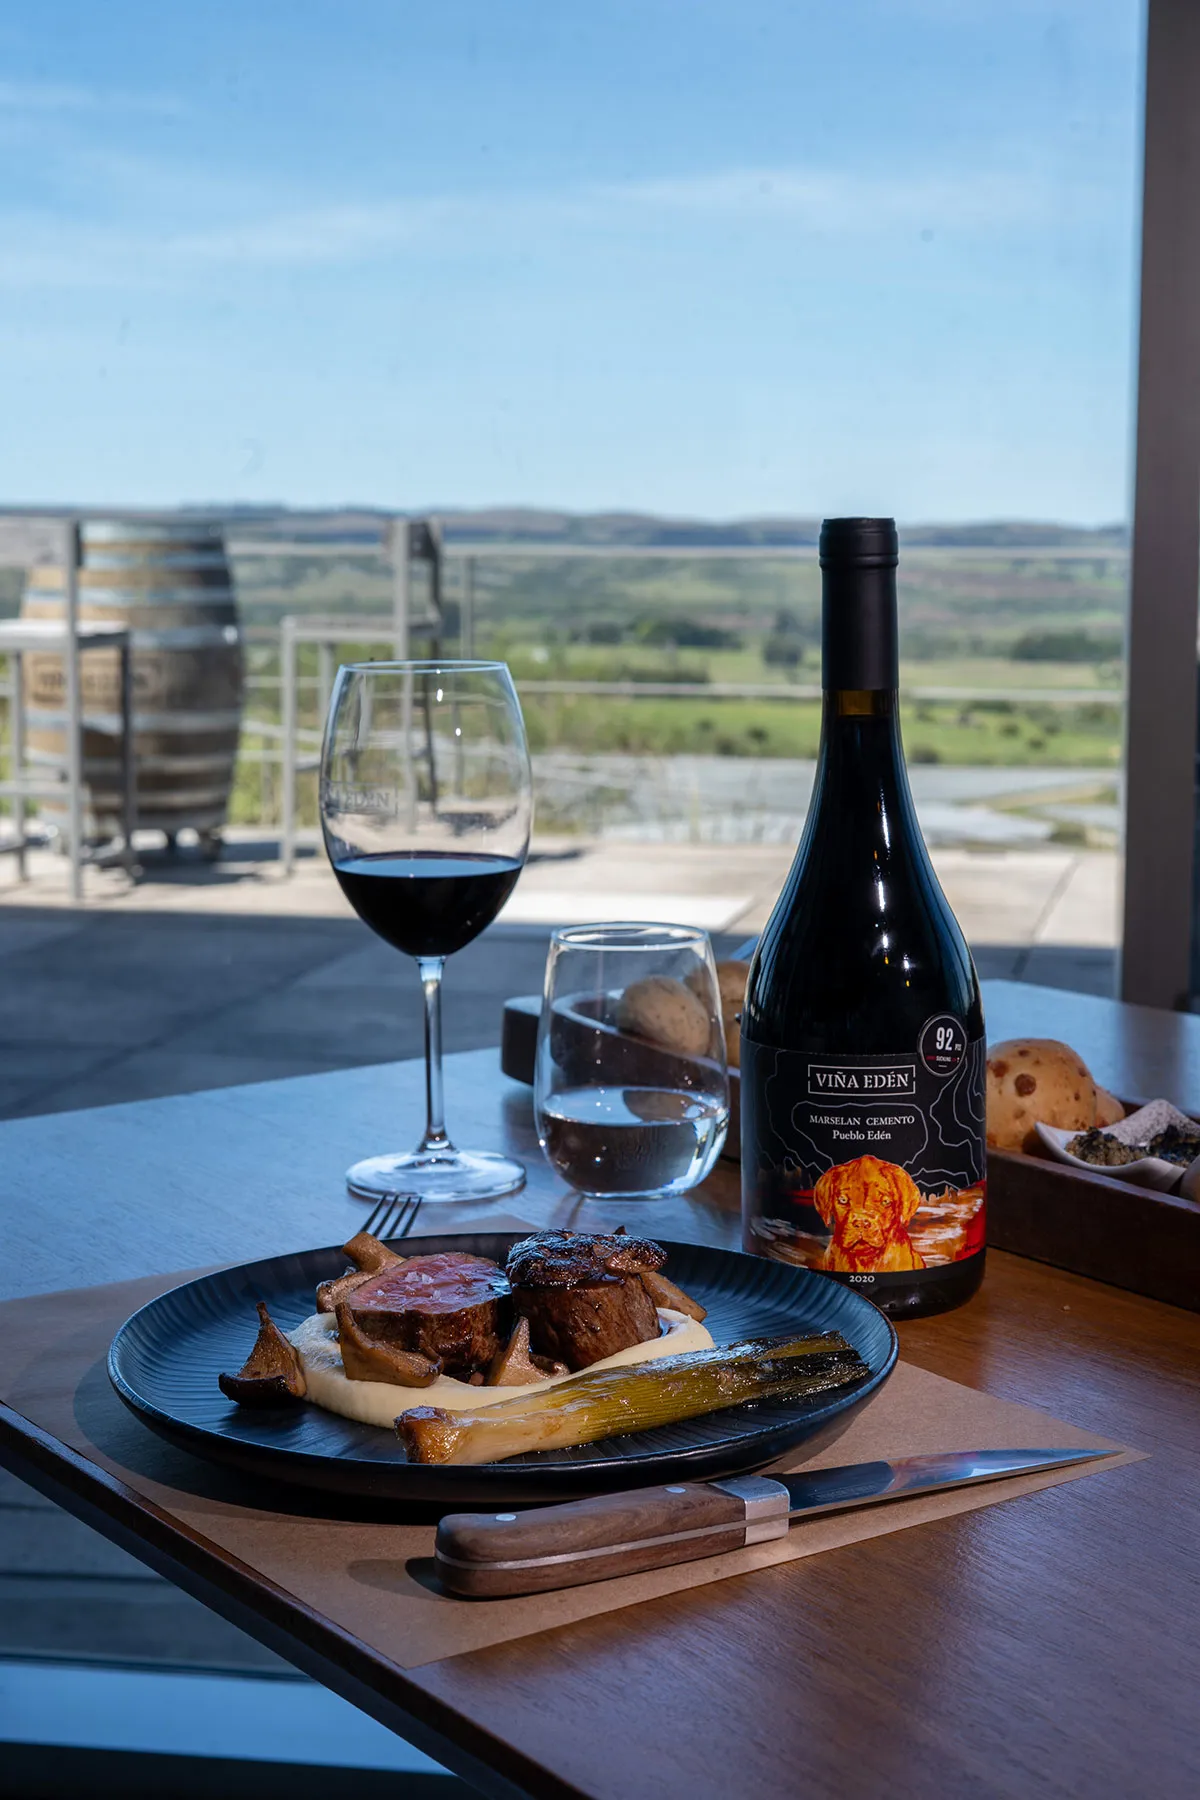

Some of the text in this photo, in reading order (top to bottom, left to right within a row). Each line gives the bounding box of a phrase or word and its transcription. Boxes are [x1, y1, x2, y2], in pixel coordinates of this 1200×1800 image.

[936, 1026, 954, 1051] 92
[815, 1071, 909, 1088] VIÑA EDÉN
[809, 1114, 915, 1126] MARSELAN CEMENTO
[832, 1129, 892, 1140] Pueblo Edén
[849, 1275, 875, 1283] 2020
